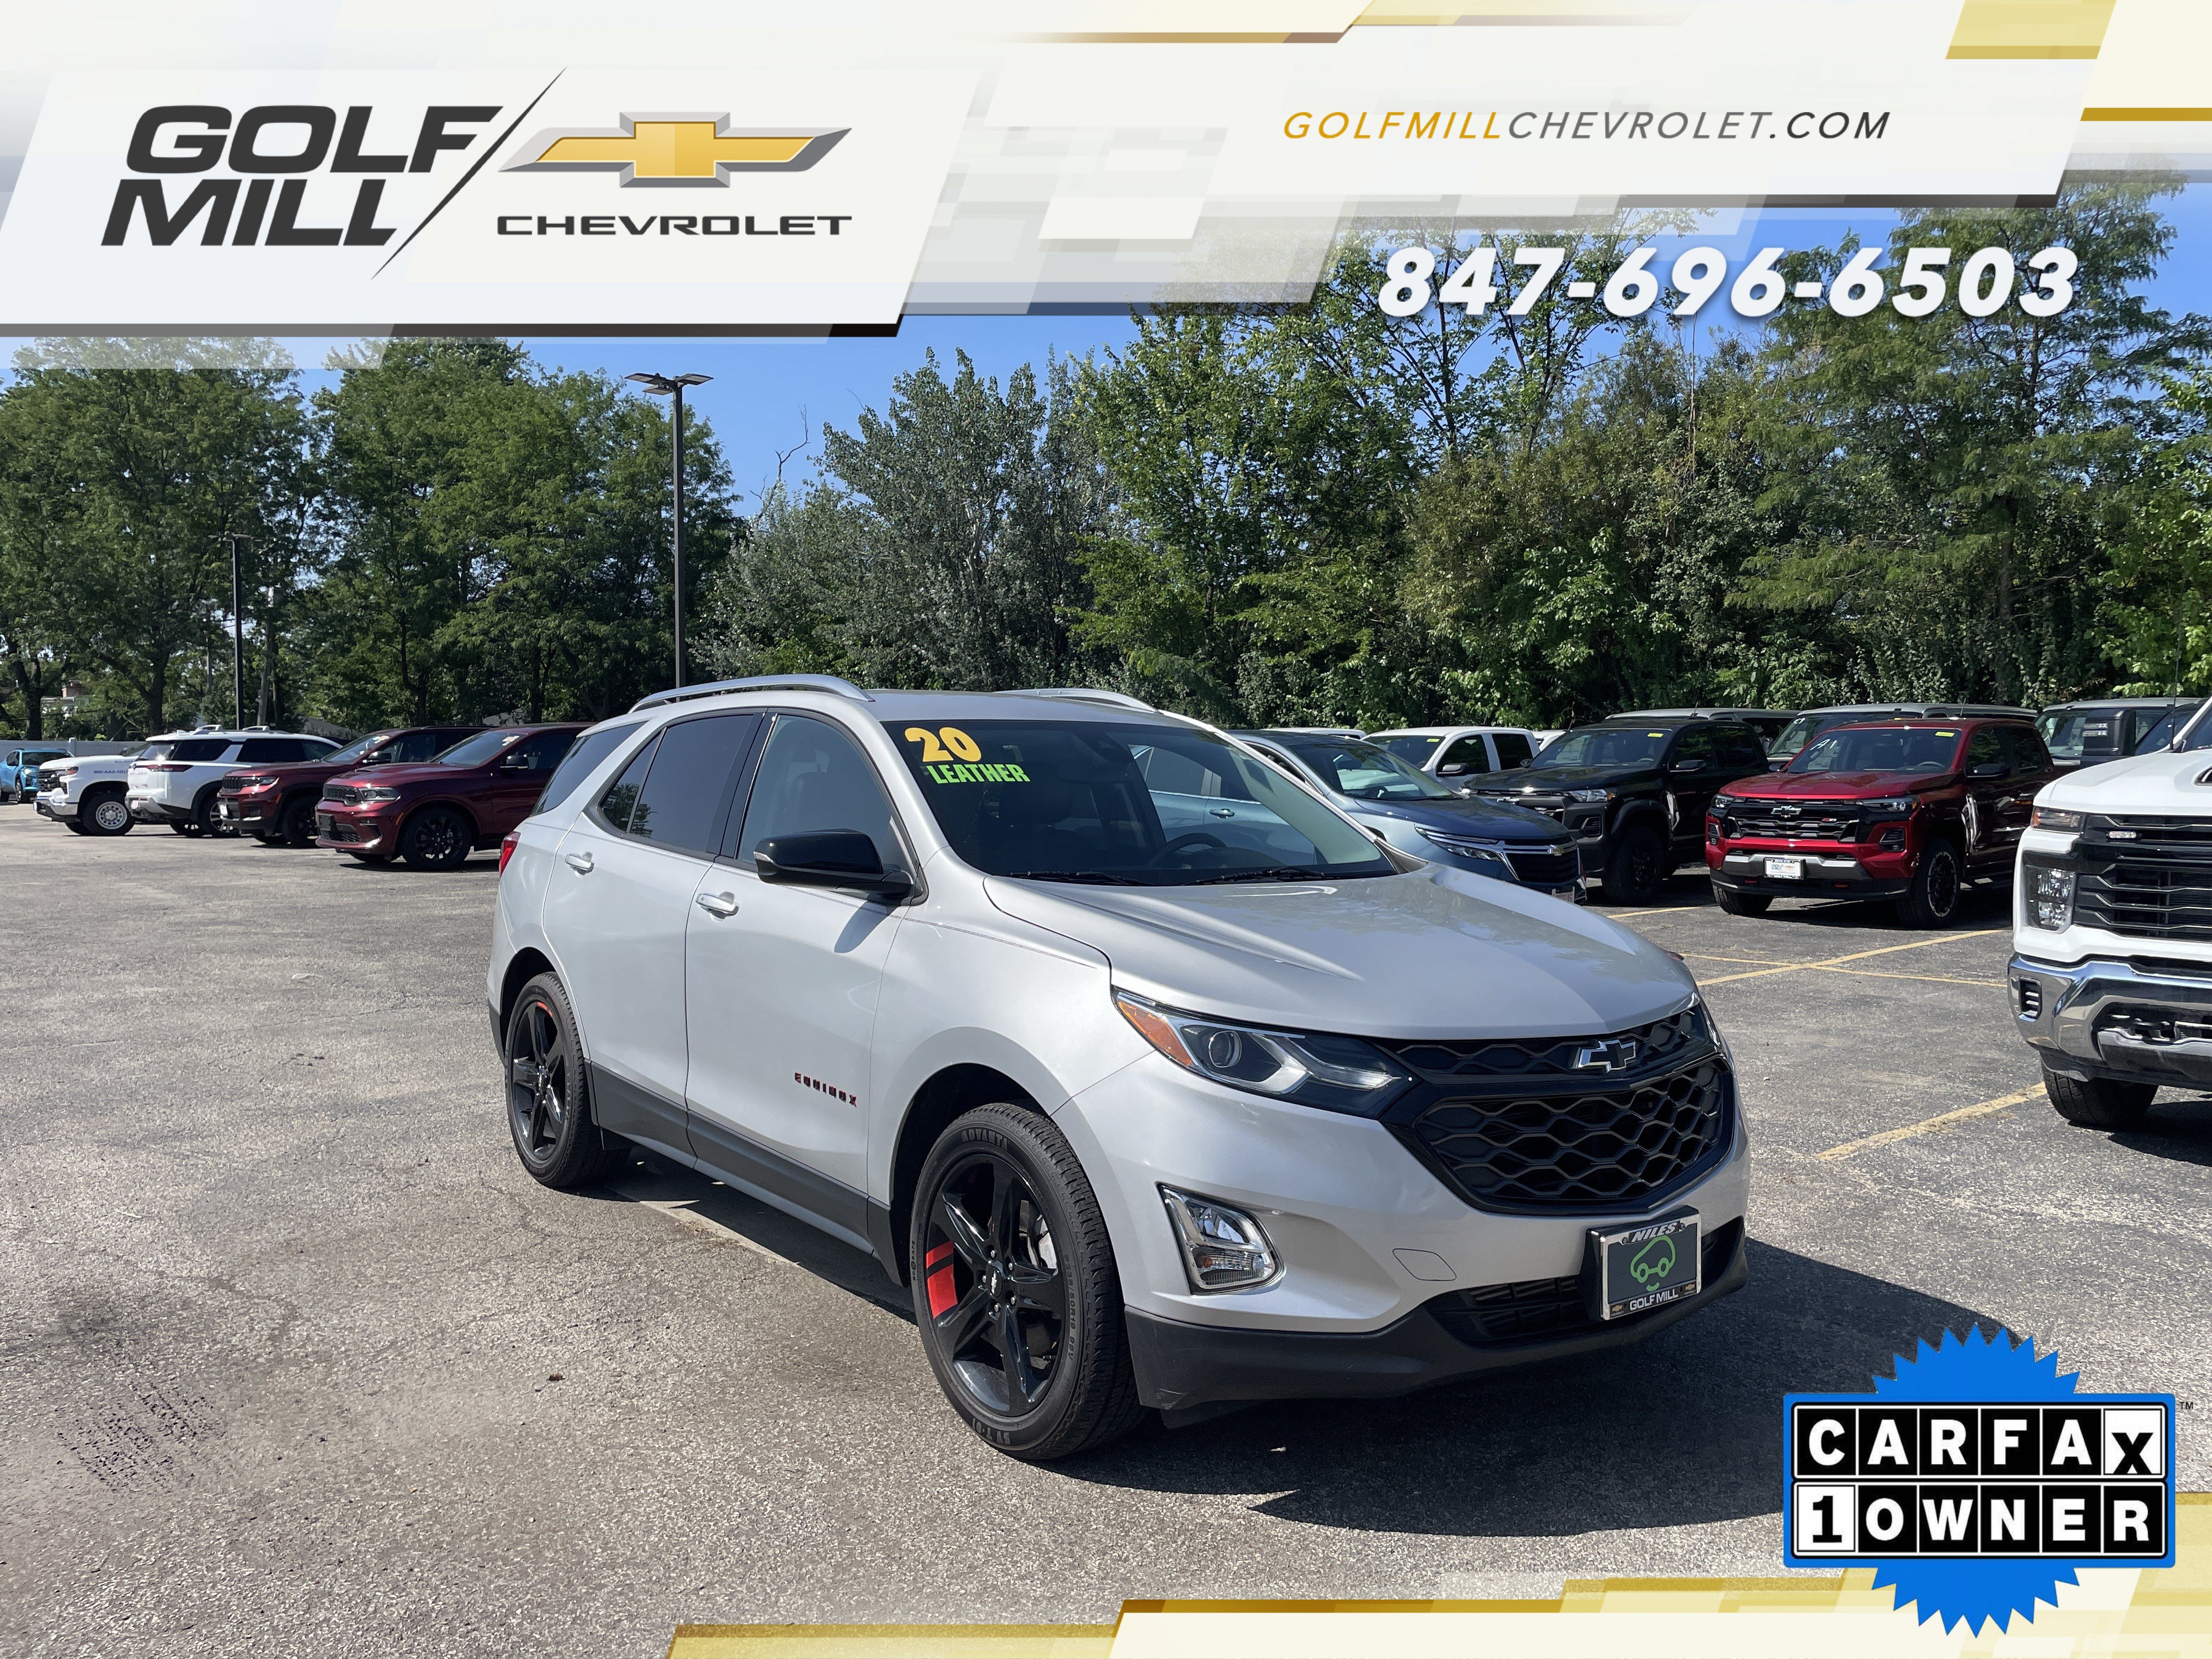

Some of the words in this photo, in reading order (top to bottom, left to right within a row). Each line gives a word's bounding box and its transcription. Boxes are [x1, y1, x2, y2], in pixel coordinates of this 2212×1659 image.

[904, 726, 981, 763] 20
[926, 764, 1031, 784] LEATHER
[794, 1071, 857, 1108] EQUINOX
[961, 1128, 1009, 1151] ADVANTA
[1632, 1222, 1678, 1243] NILES
[1629, 1294, 1656, 1311] GOLF
[1656, 1289, 1679, 1304] MILL
